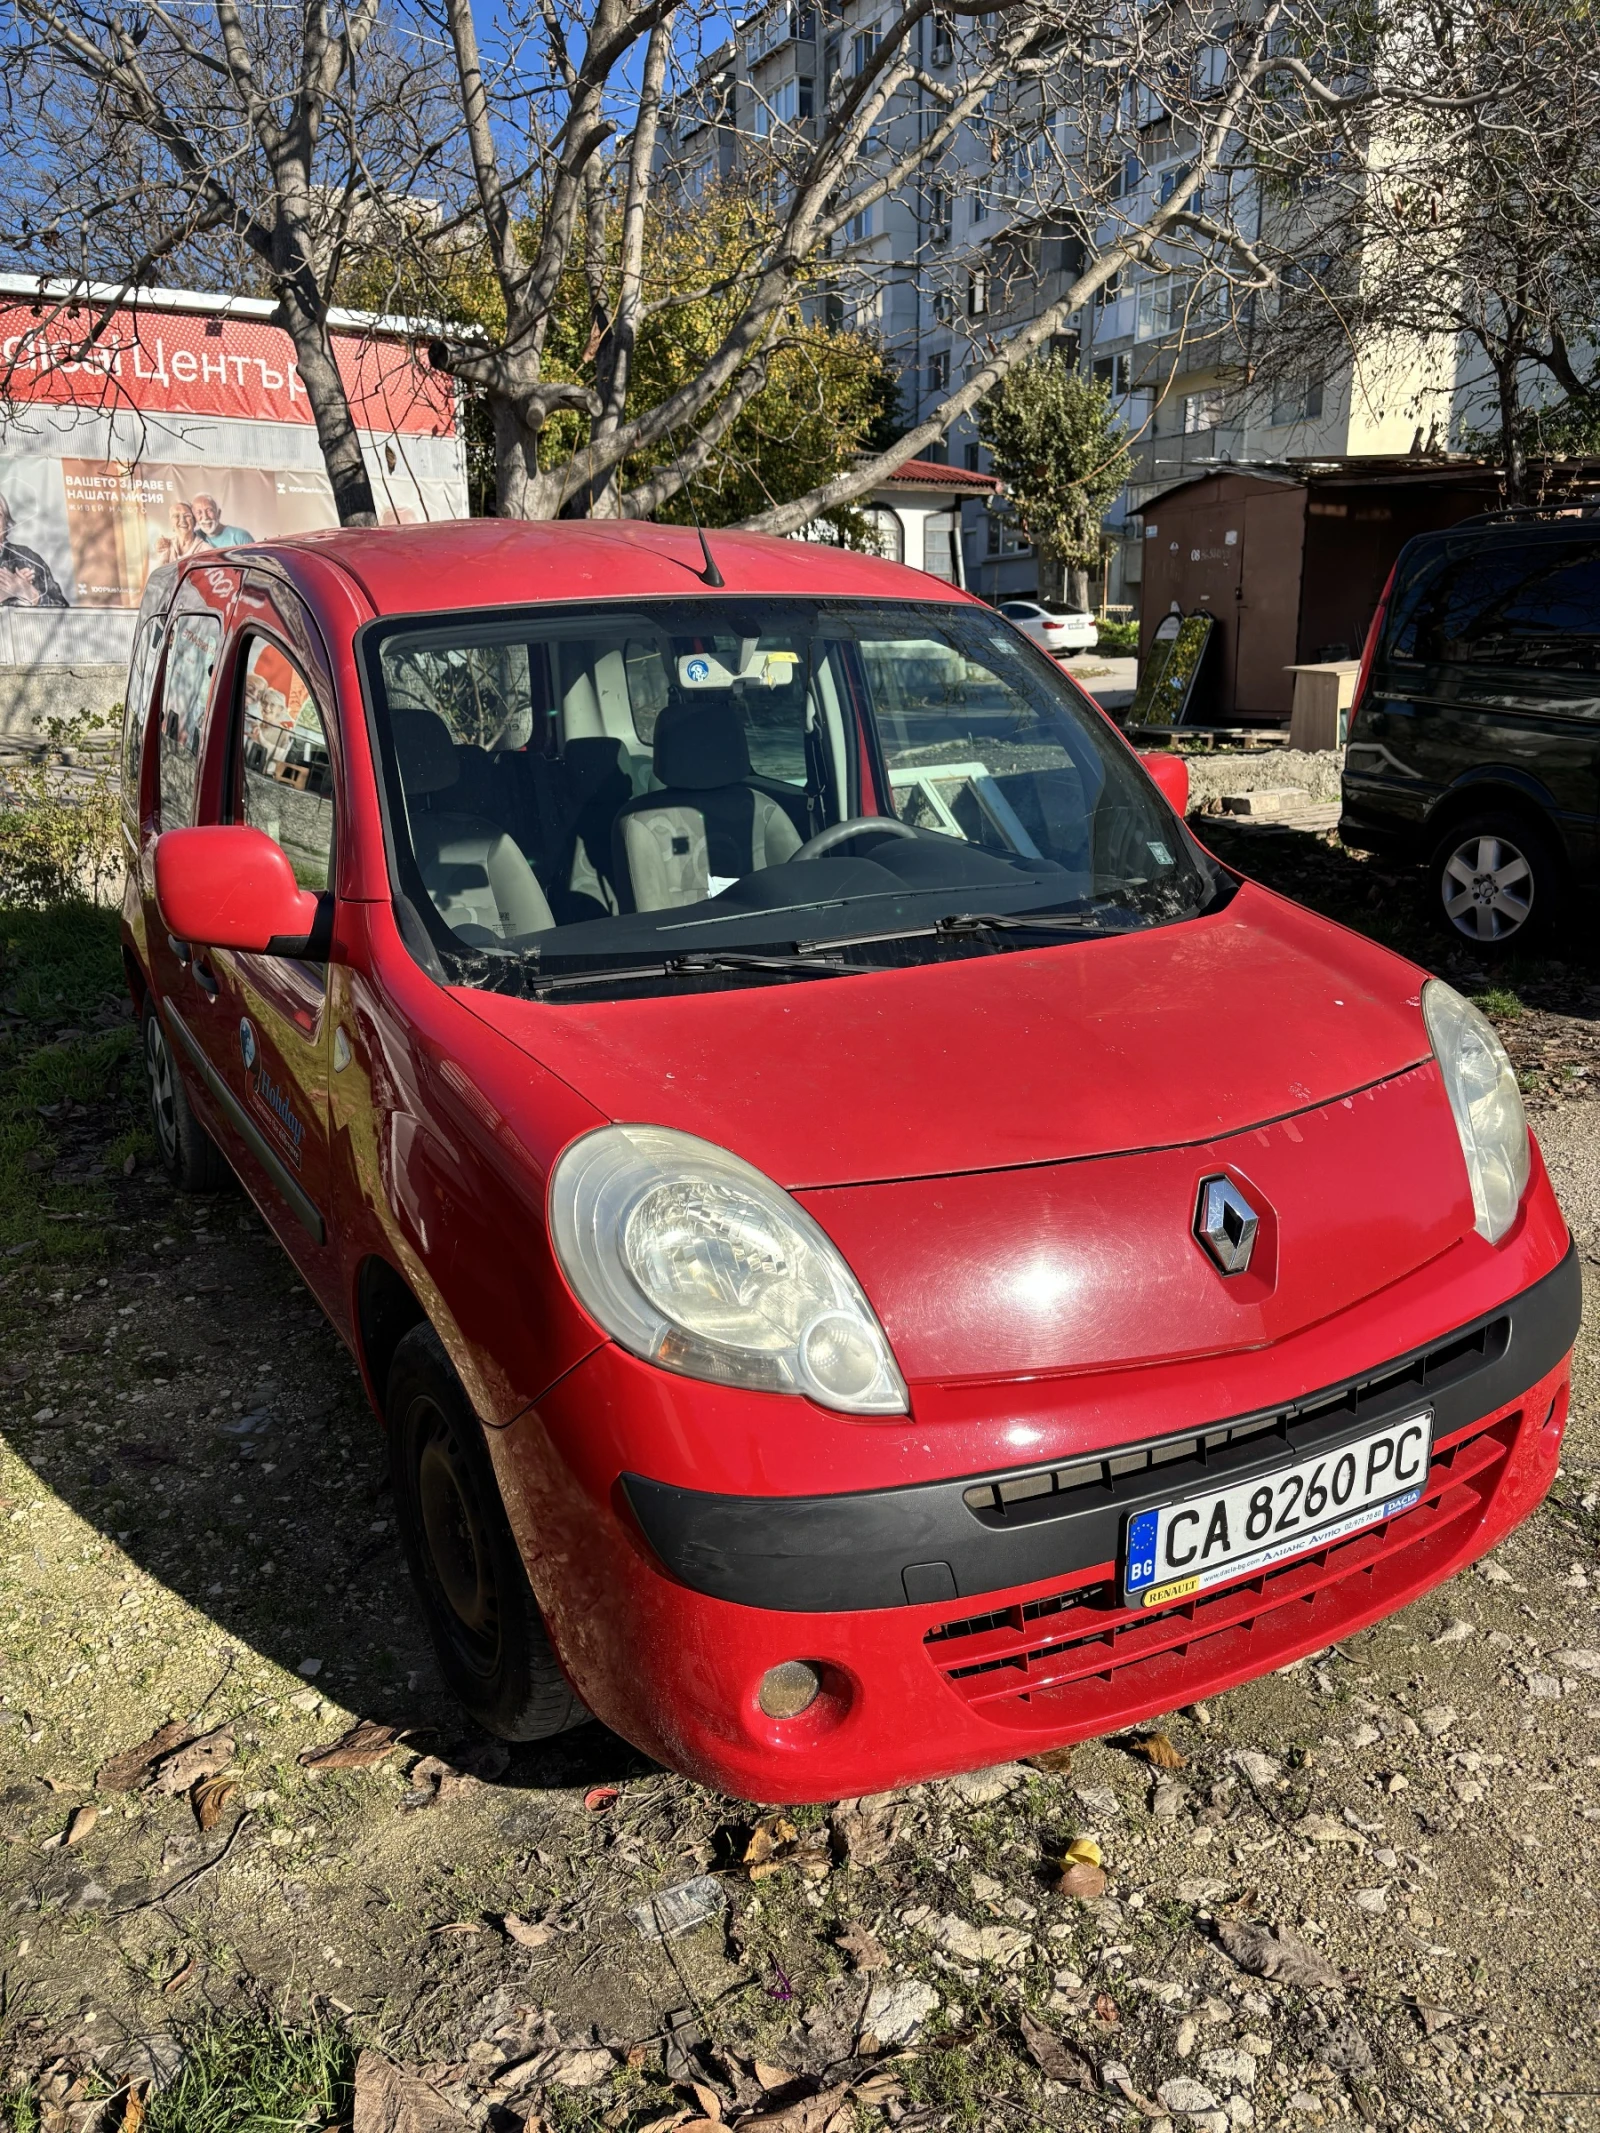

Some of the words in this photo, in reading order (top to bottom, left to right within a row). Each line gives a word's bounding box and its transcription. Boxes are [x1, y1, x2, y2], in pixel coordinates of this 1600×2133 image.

[65, 475, 117, 488] ВАШЕТО
[166, 480, 174, 491] Е
[67, 489, 119, 502] НАШАТА
[121, 491, 164, 504] МИСИЯ
[68, 503, 104, 513] ЖИВЕЙ
[1165, 1499, 1231, 1568] CA
[1245, 1452, 1356, 1541] 8260
[1364, 1425, 1422, 1496] PC
[1388, 1492, 1417, 1510] DACIA
[1130, 1559, 1153, 1582] BG
[1203, 1557, 1261, 1583] www.dacia-bg.com
[1149, 1579, 1197, 1604] RENAULT
